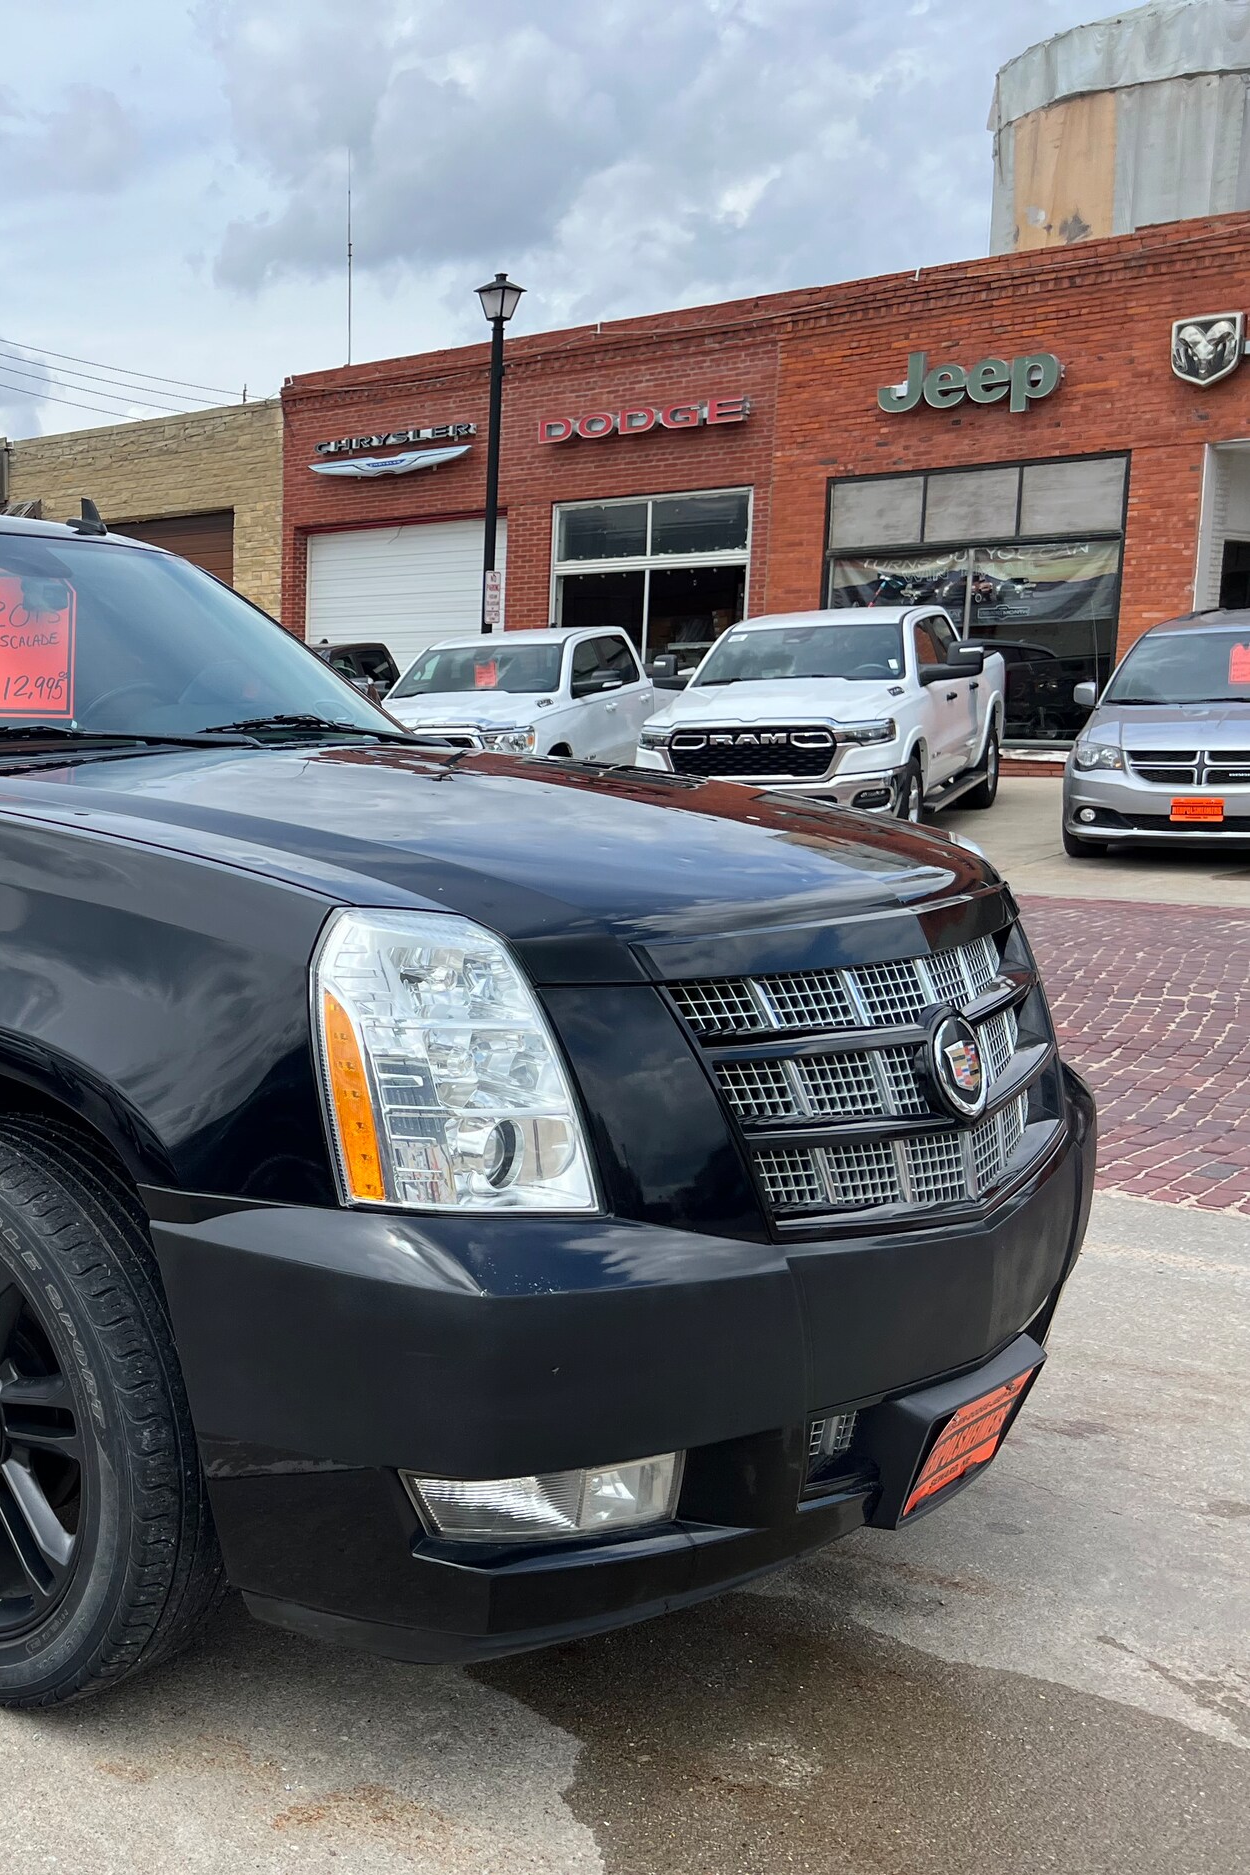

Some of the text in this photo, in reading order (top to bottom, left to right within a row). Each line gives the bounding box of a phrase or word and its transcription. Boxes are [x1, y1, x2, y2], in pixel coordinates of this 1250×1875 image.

[877, 351, 1062, 413] Jeep
[314, 422, 474, 455] CHRYSLER
[537, 397, 748, 444] DODGE
[709, 732, 787, 746] RAM
[44, 1283, 107, 1430] SPORT
